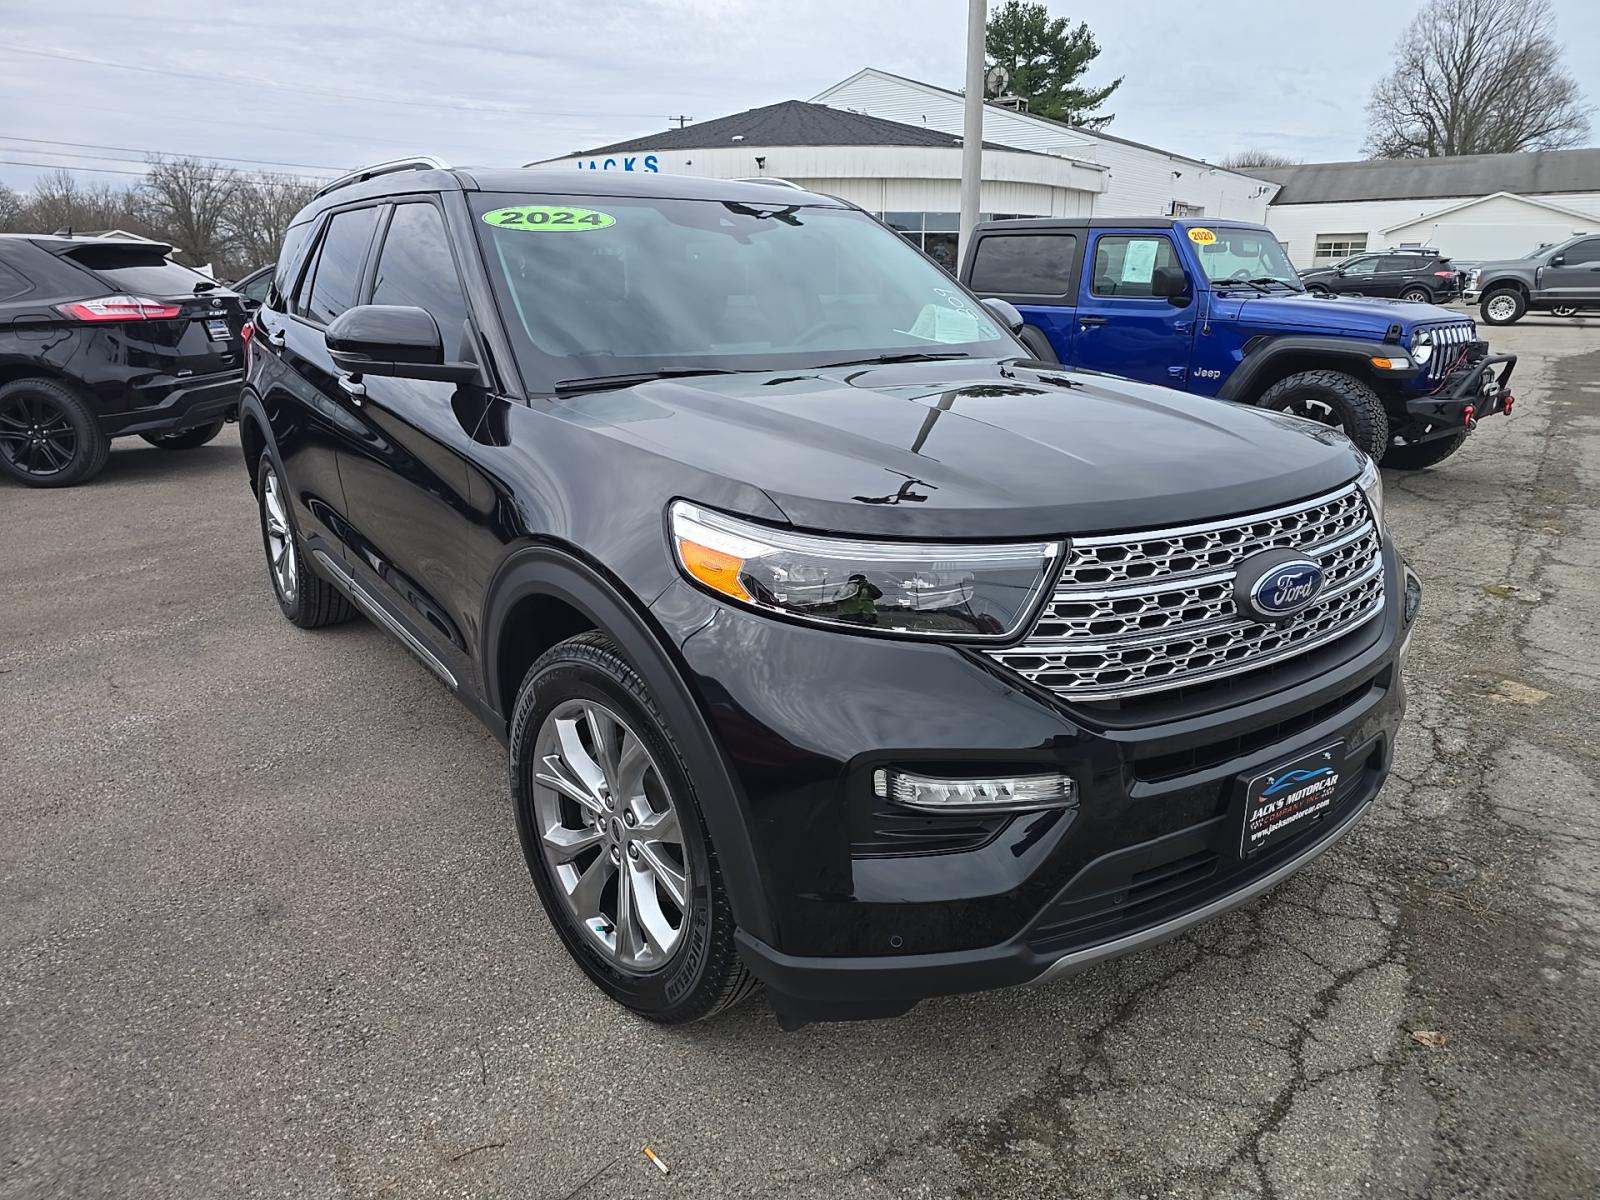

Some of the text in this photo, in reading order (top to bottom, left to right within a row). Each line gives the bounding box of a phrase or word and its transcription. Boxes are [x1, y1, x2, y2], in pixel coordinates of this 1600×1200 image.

[499, 212, 602, 225] 2024
[1191, 231, 1213, 240] 2020
[1194, 367, 1220, 379] Jeep
[1274, 572, 1313, 605] Ford
[1250, 798, 1285, 822] JACK'S
[1286, 774, 1339, 806] MOTORCAR
